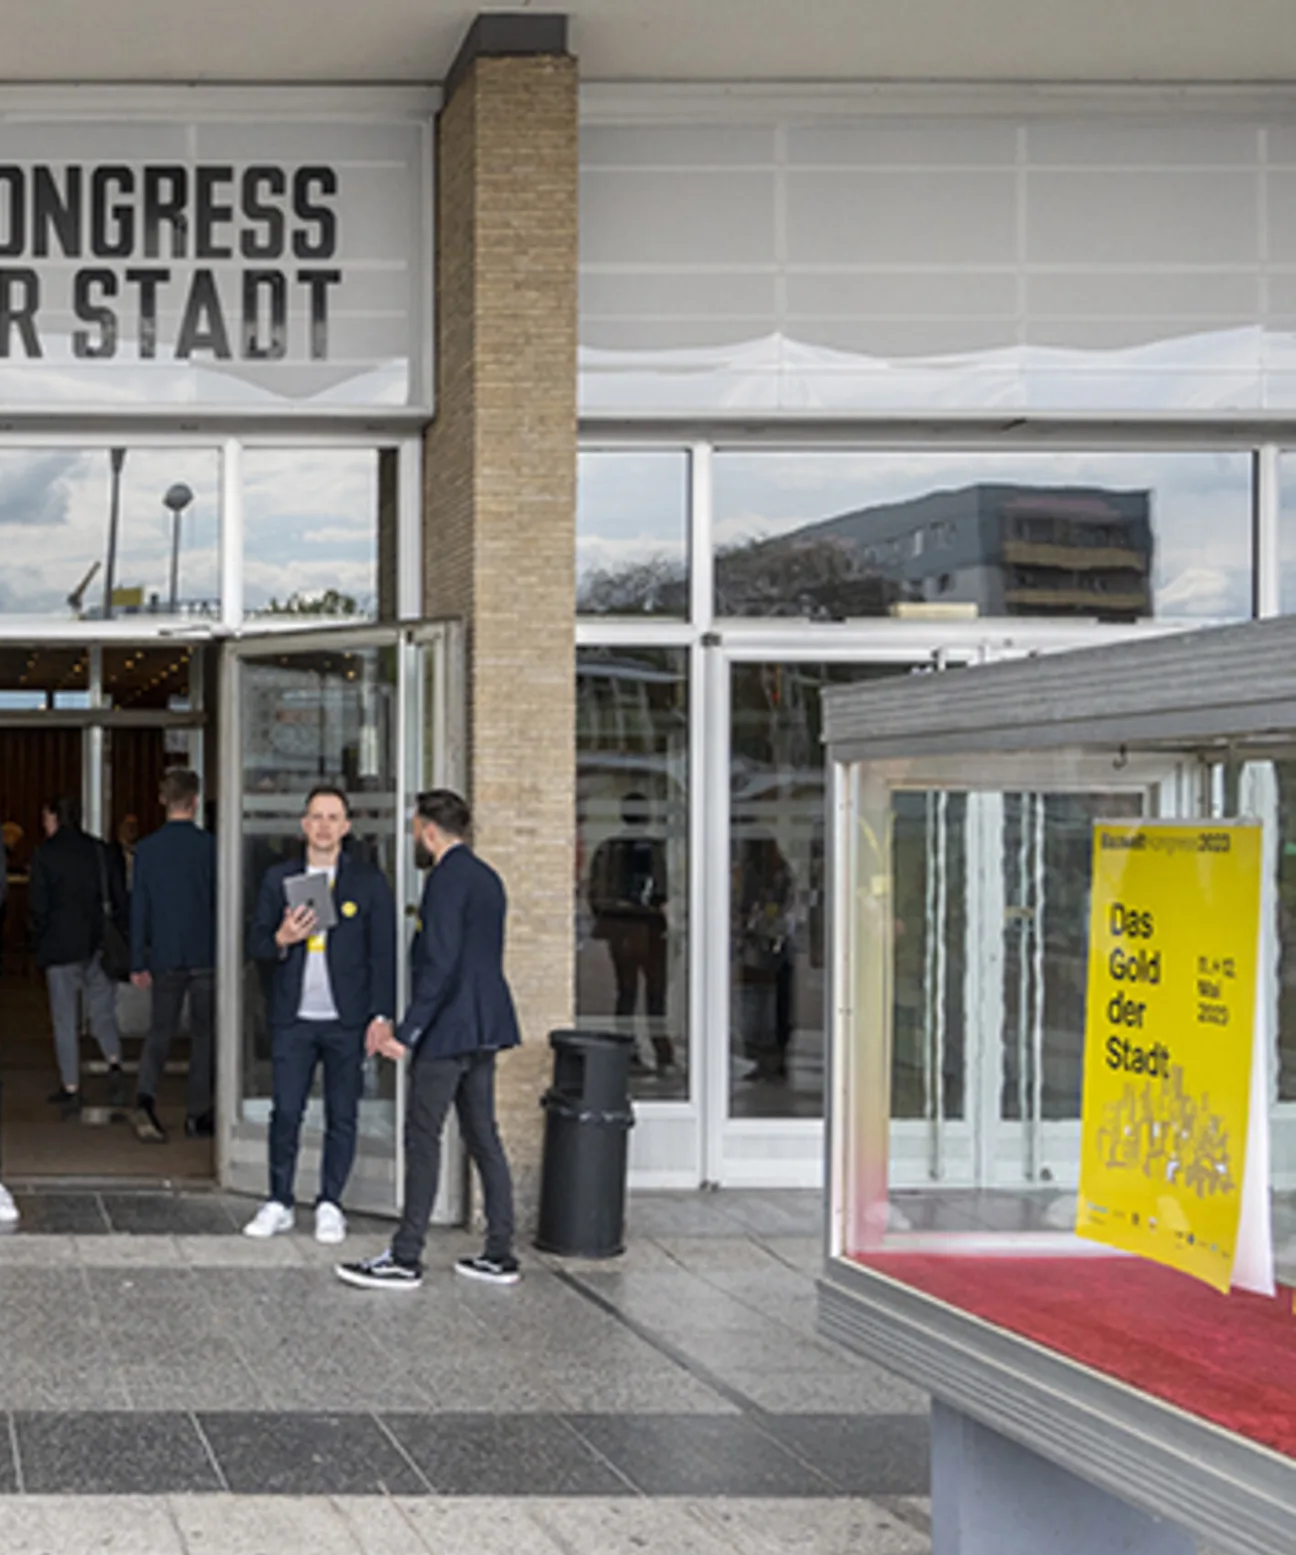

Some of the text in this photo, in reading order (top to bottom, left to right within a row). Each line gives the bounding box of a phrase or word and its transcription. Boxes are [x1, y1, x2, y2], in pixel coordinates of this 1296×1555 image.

[73, 267, 342, 359] STADT
[1110, 902, 1154, 939] Das
[1109, 947, 1161, 985] Gold
[1107, 990, 1146, 1029] der
[1105, 1036, 1169, 1079] Stadt
